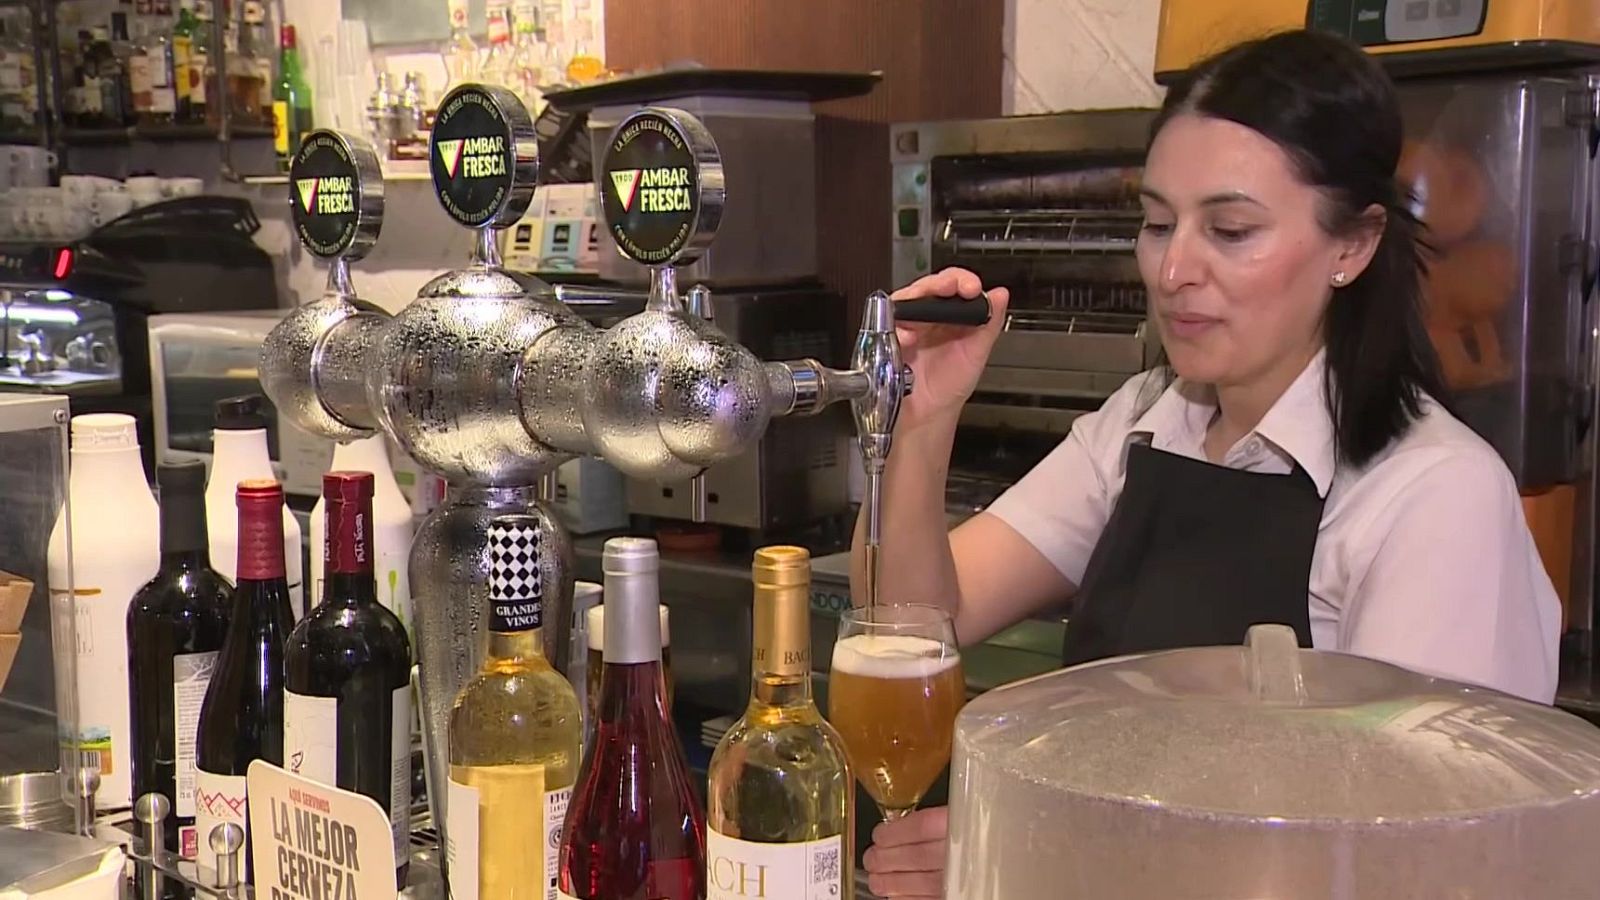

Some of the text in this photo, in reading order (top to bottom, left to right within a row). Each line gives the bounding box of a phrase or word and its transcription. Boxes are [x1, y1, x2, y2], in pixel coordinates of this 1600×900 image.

[463, 136, 505, 155] AMBAR
[463, 154, 507, 178] FRESCA
[640, 167, 690, 187] AMBAR
[318, 177, 353, 193] AMBAR
[318, 193, 355, 214] FRESCA
[640, 187, 692, 212] FRESCA
[505, 613, 539, 627] VINOS
[271, 797, 293, 847] LA
[294, 806, 360, 872] MEJOR
[277, 845, 358, 900] CERVEZA
[707, 849, 768, 897] ACH
